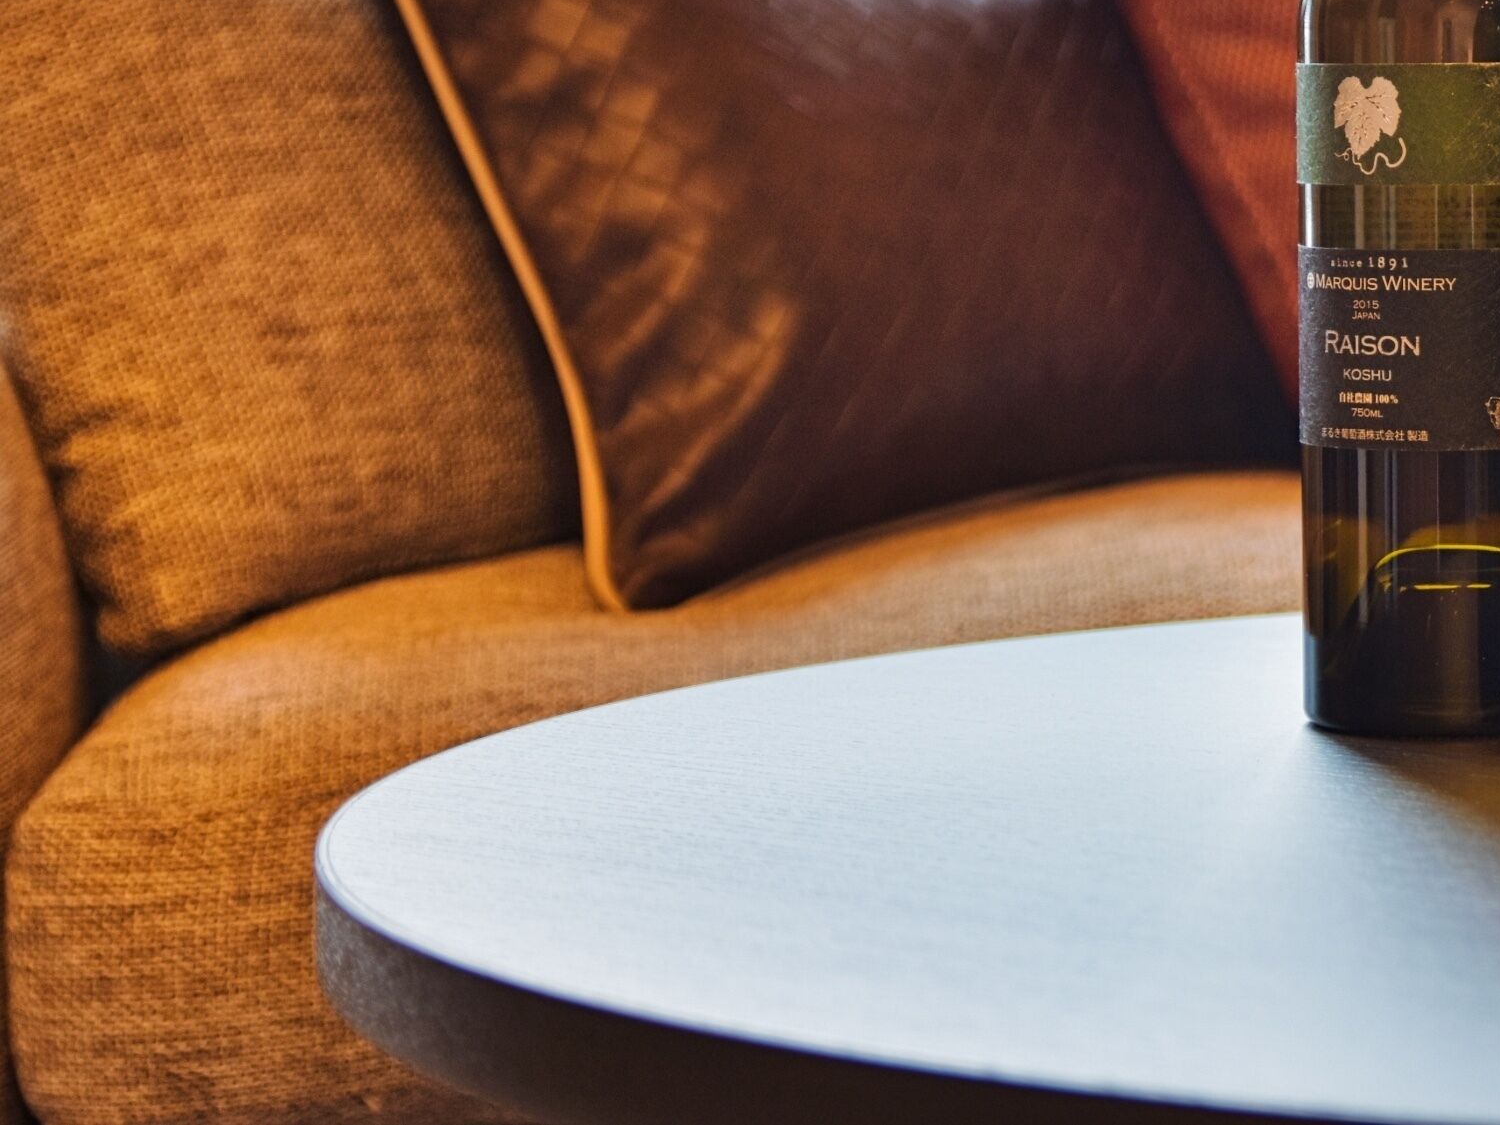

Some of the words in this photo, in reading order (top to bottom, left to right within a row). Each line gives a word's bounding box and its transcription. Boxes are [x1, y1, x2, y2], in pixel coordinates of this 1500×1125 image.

[1330, 258, 1363, 268] since
[1368, 256, 1409, 270] 1891
[1315, 273, 1378, 291] MARQUIS
[1382, 275, 1457, 291] WINERY
[1353, 299, 1380, 310] 2015
[1351, 310, 1381, 320] JAPAN
[1324, 329, 1421, 356] RAISON
[1343, 368, 1392, 382] KOSHU
[1351, 407, 1384, 418] 750ML
